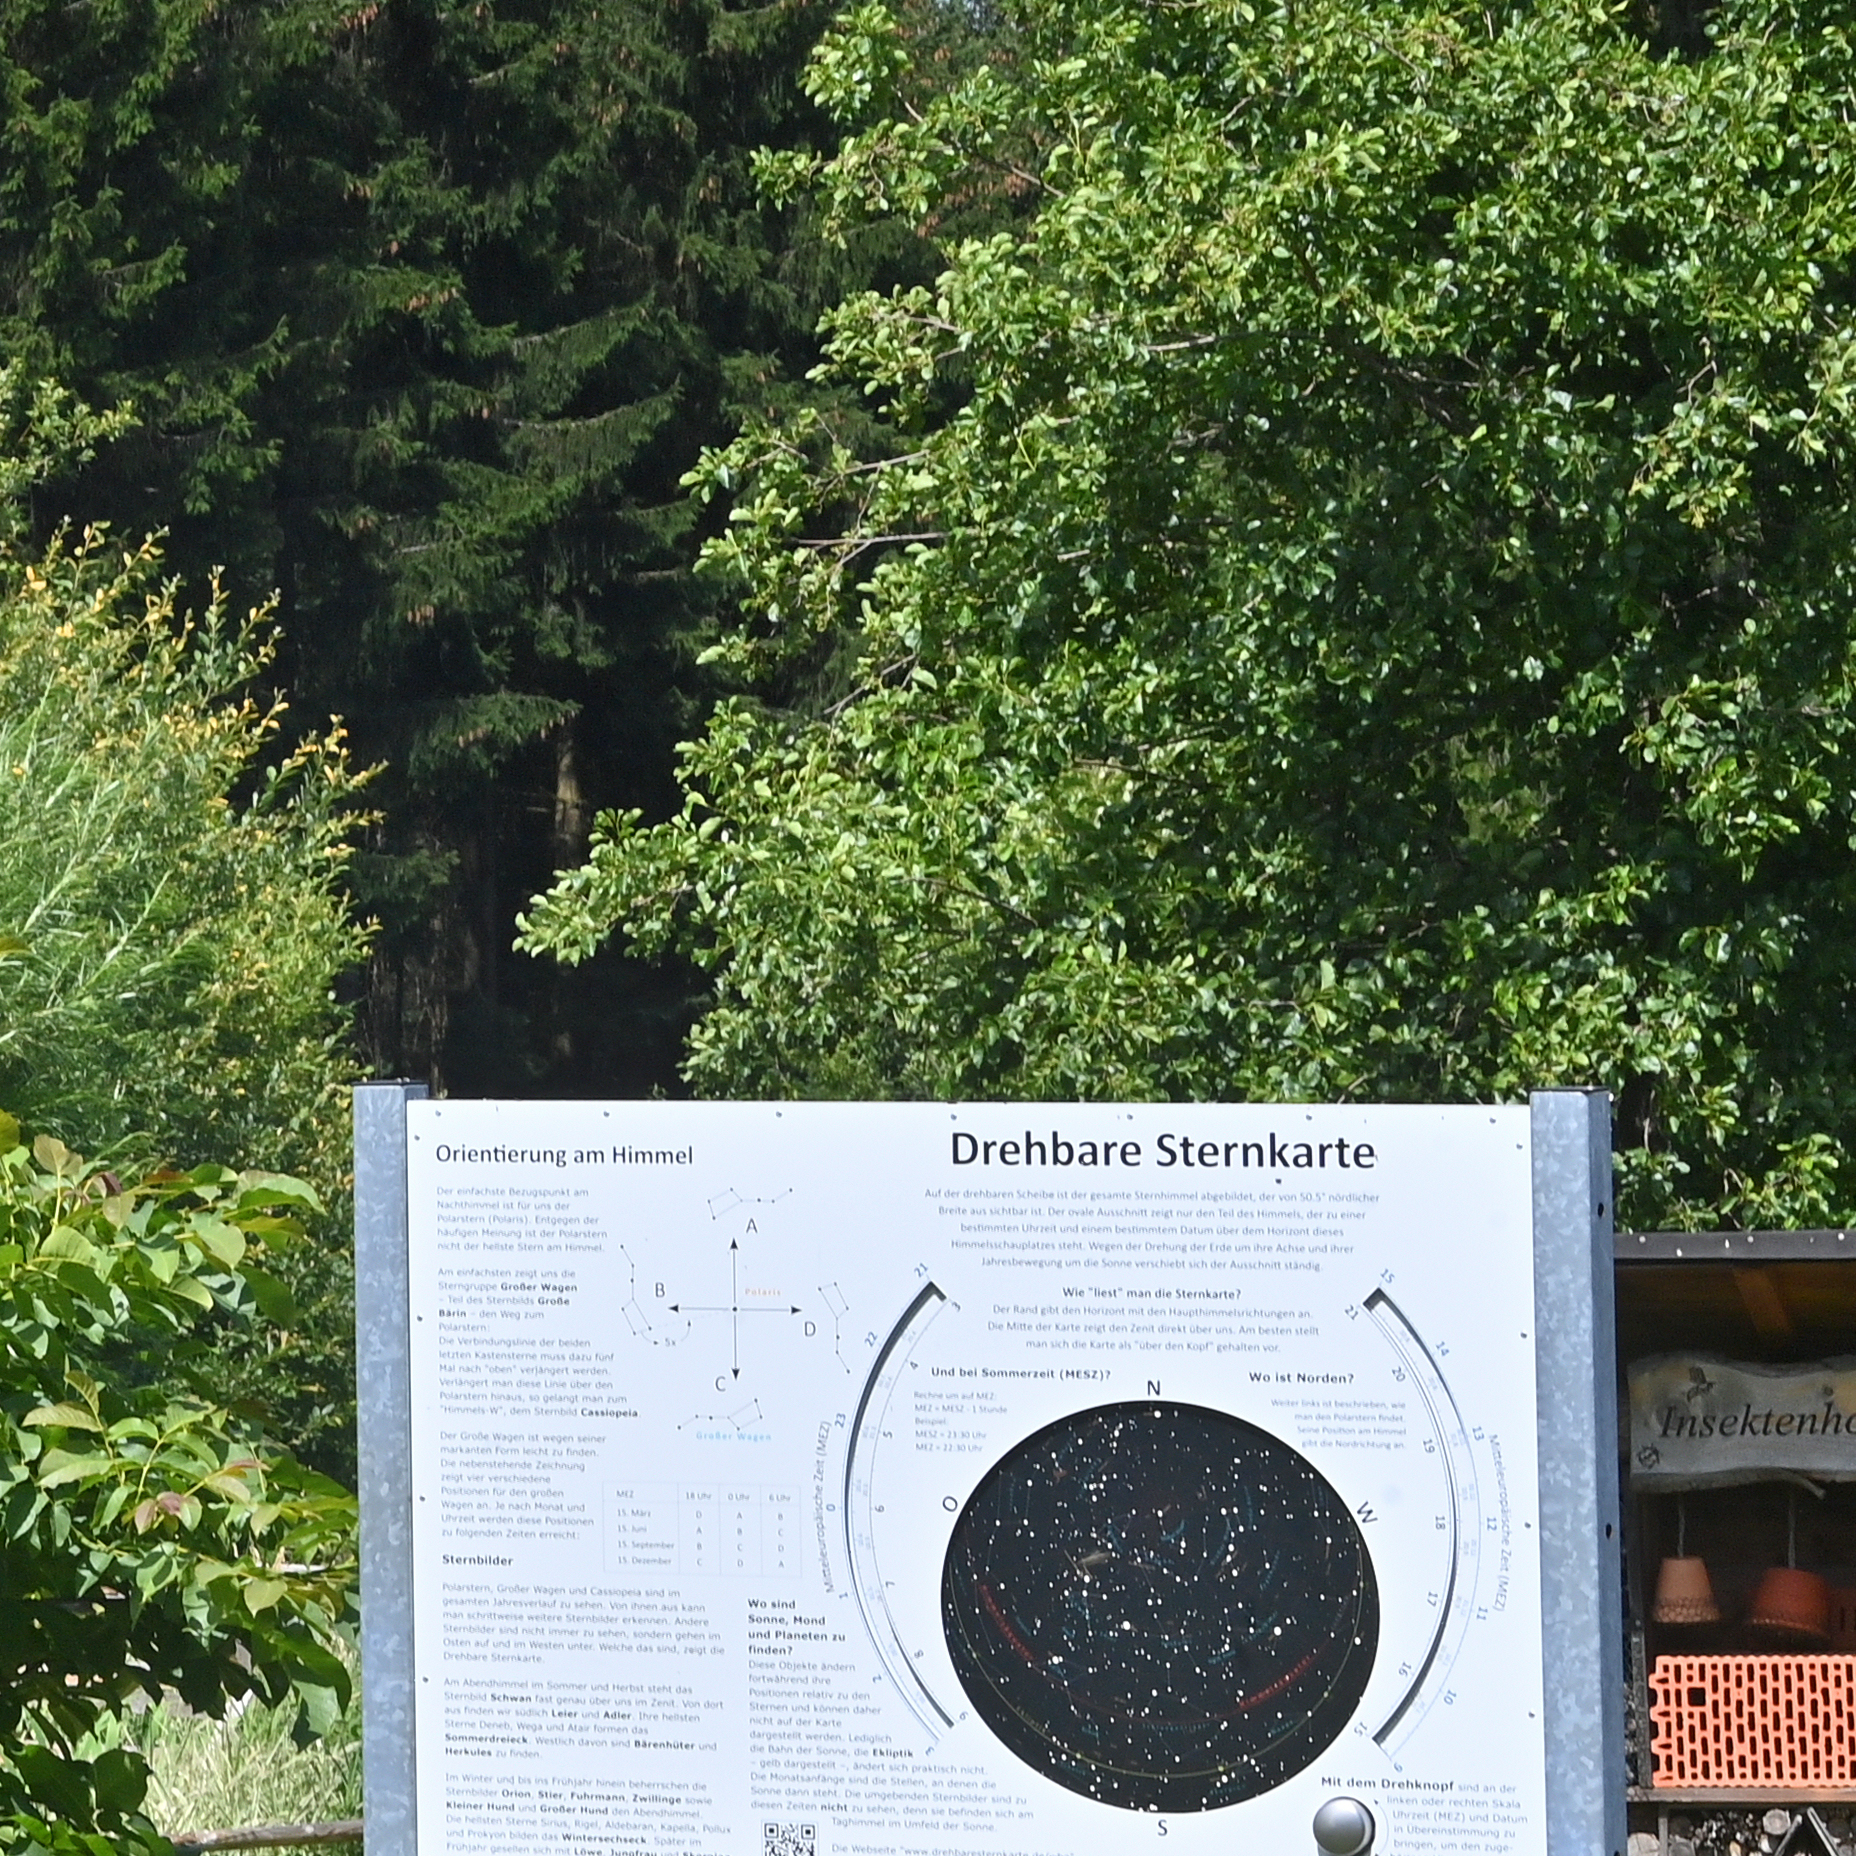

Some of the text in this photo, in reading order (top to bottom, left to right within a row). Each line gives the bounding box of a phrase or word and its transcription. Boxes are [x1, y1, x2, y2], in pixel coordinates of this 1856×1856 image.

[435, 1144, 693, 1168] Orientierung am Himmel
[951, 1130, 1375, 1169] Drehbare Sternkarte
[746, 1218, 759, 1233] A
[914, 1262, 928, 1278] 21
[1380, 1268, 1395, 1284] 15
[438, 1282, 578, 1294] Sterngruppe Großer Wagen
[655, 1282, 665, 1298] B
[744, 1287, 781, 1297] Polaris
[1062, 1287, 1242, 1300] Wie "liest" man die Sternkarte?
[1344, 1304, 1358, 1320] 21
[804, 1322, 816, 1337] D
[664, 1338, 676, 1347] 5x
[864, 1332, 878, 1348] 22
[1435, 1341, 1450, 1356] 14
[931, 1366, 1111, 1382] Und bei Sommerzeit (MESZ)?
[1248, 1372, 1354, 1384] Wo ist Norden?
[1391, 1366, 1406, 1382] 20
[715, 1377, 726, 1392] C
[1148, 1380, 1160, 1396] N
[835, 1413, 846, 1428] 23
[695, 1430, 772, 1443] Großer Wagen
[1472, 1426, 1485, 1441] 13
[1423, 1439, 1435, 1453] 19
[813, 1421, 835, 1594] Mitteleuropäische Zeit (MEZ)
[942, 1496, 958, 1512] O
[1357, 1501, 1377, 1524] W
[1436, 1515, 1445, 1530] 18
[1487, 1517, 1497, 1531] 12
[1489, 1434, 1512, 1612] Mitteleuropäische Zeit (MEZ)
[442, 1554, 512, 1566] Sternbilder
[747, 1598, 796, 1609] Wo sind
[1427, 1591, 1438, 1607] 17
[747, 1614, 826, 1626] Sonne, Mond
[1477, 1606, 1488, 1621] 11
[747, 1629, 846, 1642] und Planeten zu
[748, 1644, 793, 1656] finden?
[1399, 1661, 1412, 1677] 16
[1443, 1689, 1457, 1705] 10
[1354, 1721, 1368, 1737] 15
[1320, 1776, 1517, 1794] Mit dem Drehknopf sind an der
[1158, 1819, 1168, 1836] S
